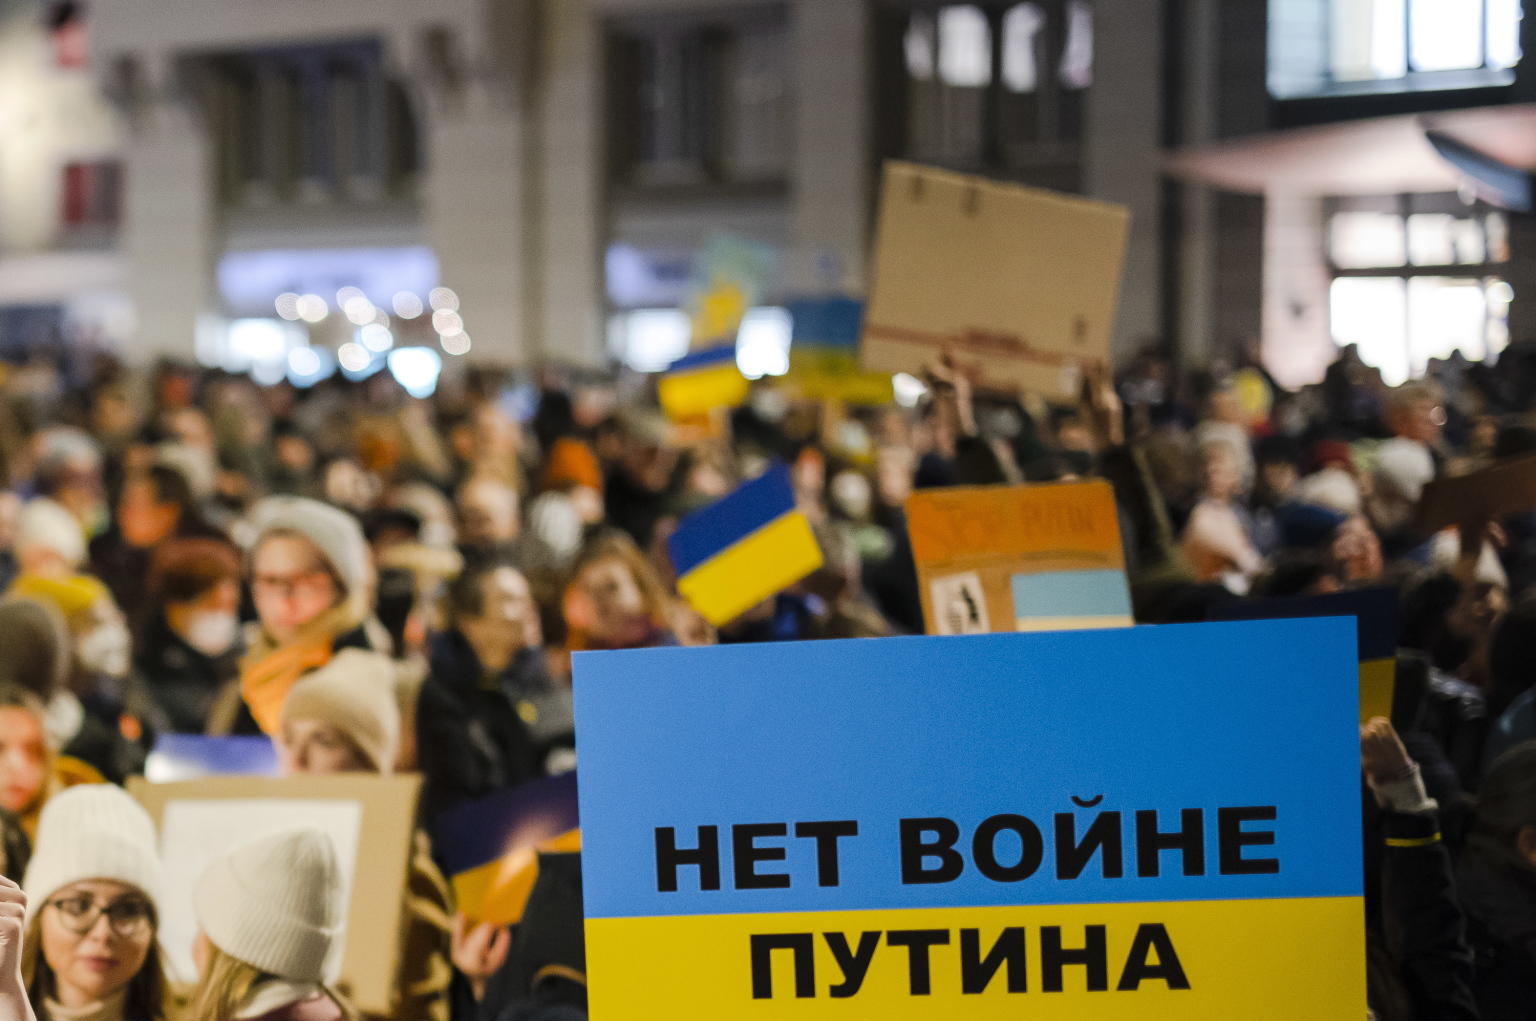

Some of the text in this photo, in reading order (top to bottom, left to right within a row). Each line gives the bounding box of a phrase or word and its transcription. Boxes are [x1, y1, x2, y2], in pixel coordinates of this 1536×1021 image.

[654, 794, 1280, 893] НЕТ ВОЙНЕ
[750, 923, 1191, 999] ПУТИНА
